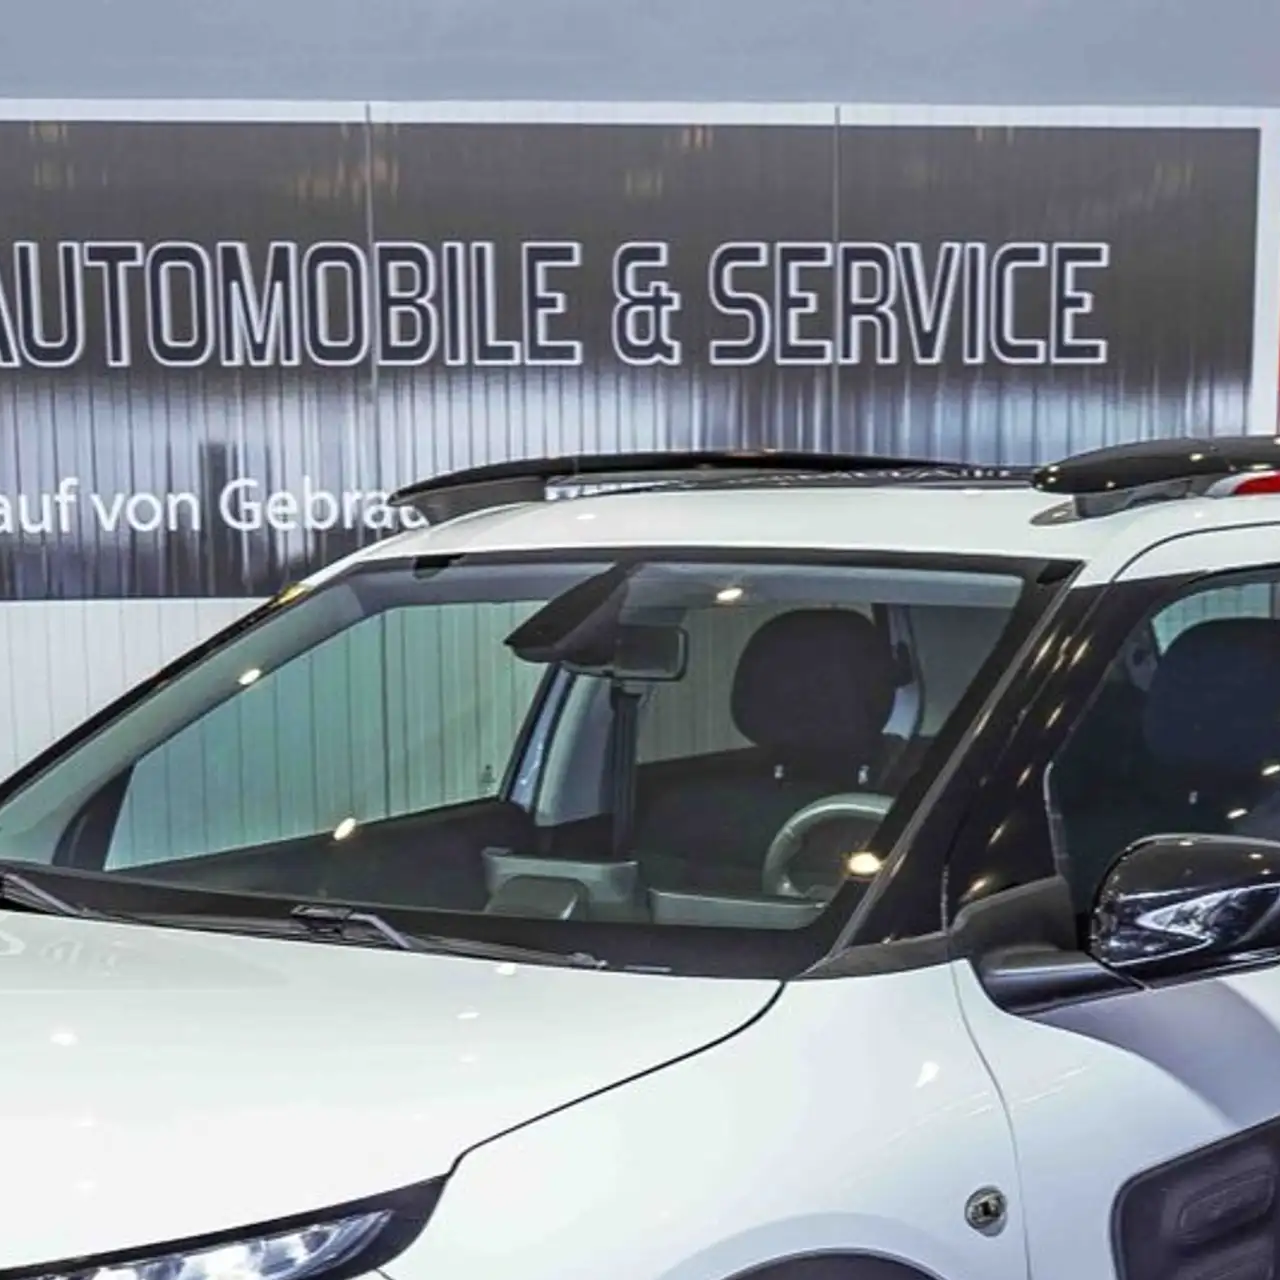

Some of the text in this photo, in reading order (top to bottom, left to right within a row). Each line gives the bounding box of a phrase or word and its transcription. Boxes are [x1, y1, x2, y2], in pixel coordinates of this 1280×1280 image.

[612, 241, 682, 368] &
[710, 241, 1111, 368] SERVICE
[87, 490, 201, 533] von
